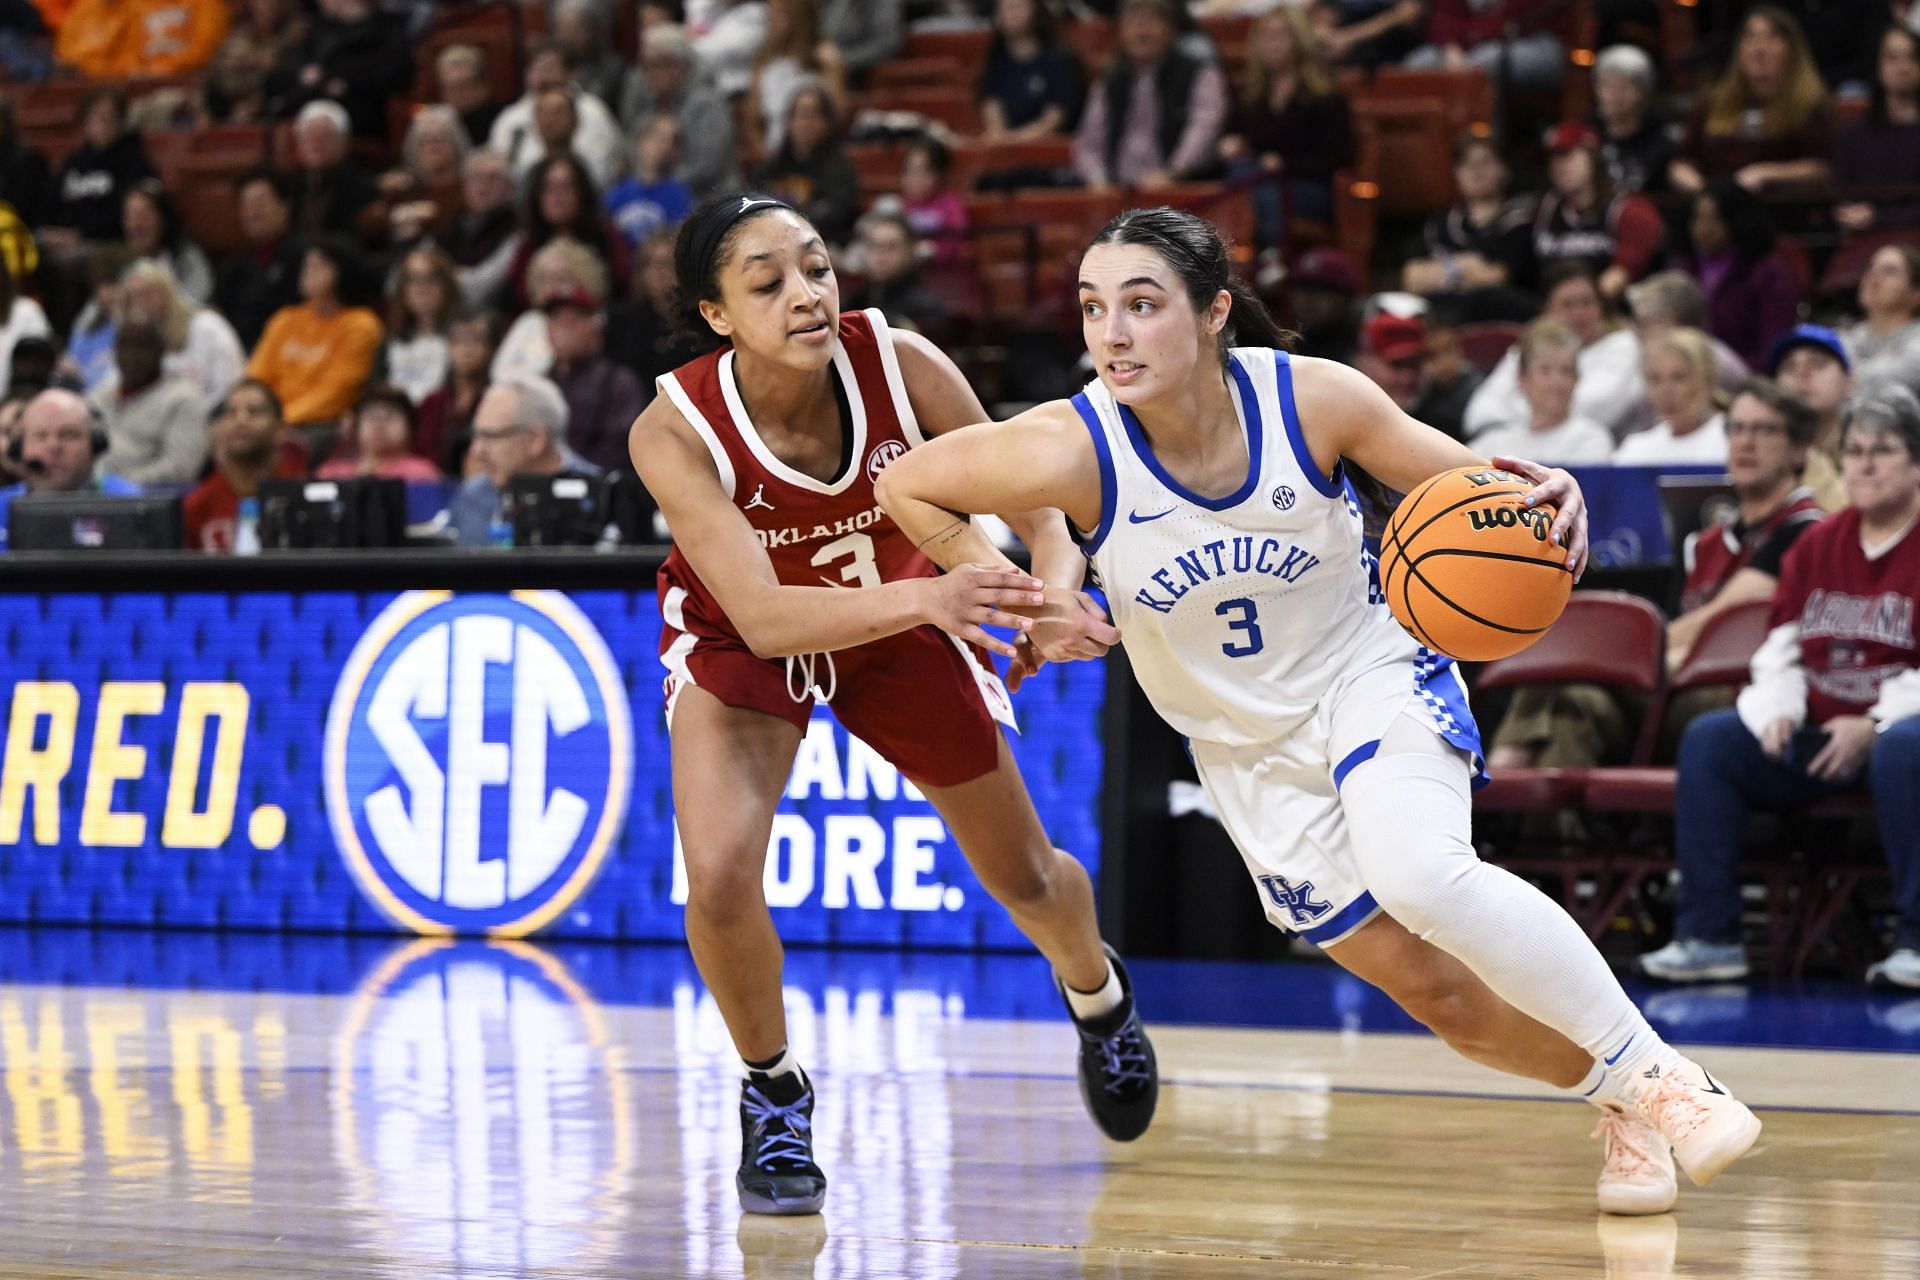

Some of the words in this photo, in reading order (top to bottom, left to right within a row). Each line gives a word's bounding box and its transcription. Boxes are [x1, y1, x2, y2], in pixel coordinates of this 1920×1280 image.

[1273, 487, 1295, 509] SEC
[1467, 507, 1569, 551] lson
[810, 531, 882, 588] 3
[1135, 536, 1321, 614] KENTUCKY
[1215, 597, 1264, 658] 3
[0, 682, 287, 849] RED.
[363, 615, 591, 907] SEC
[1258, 874, 1334, 926] UK
